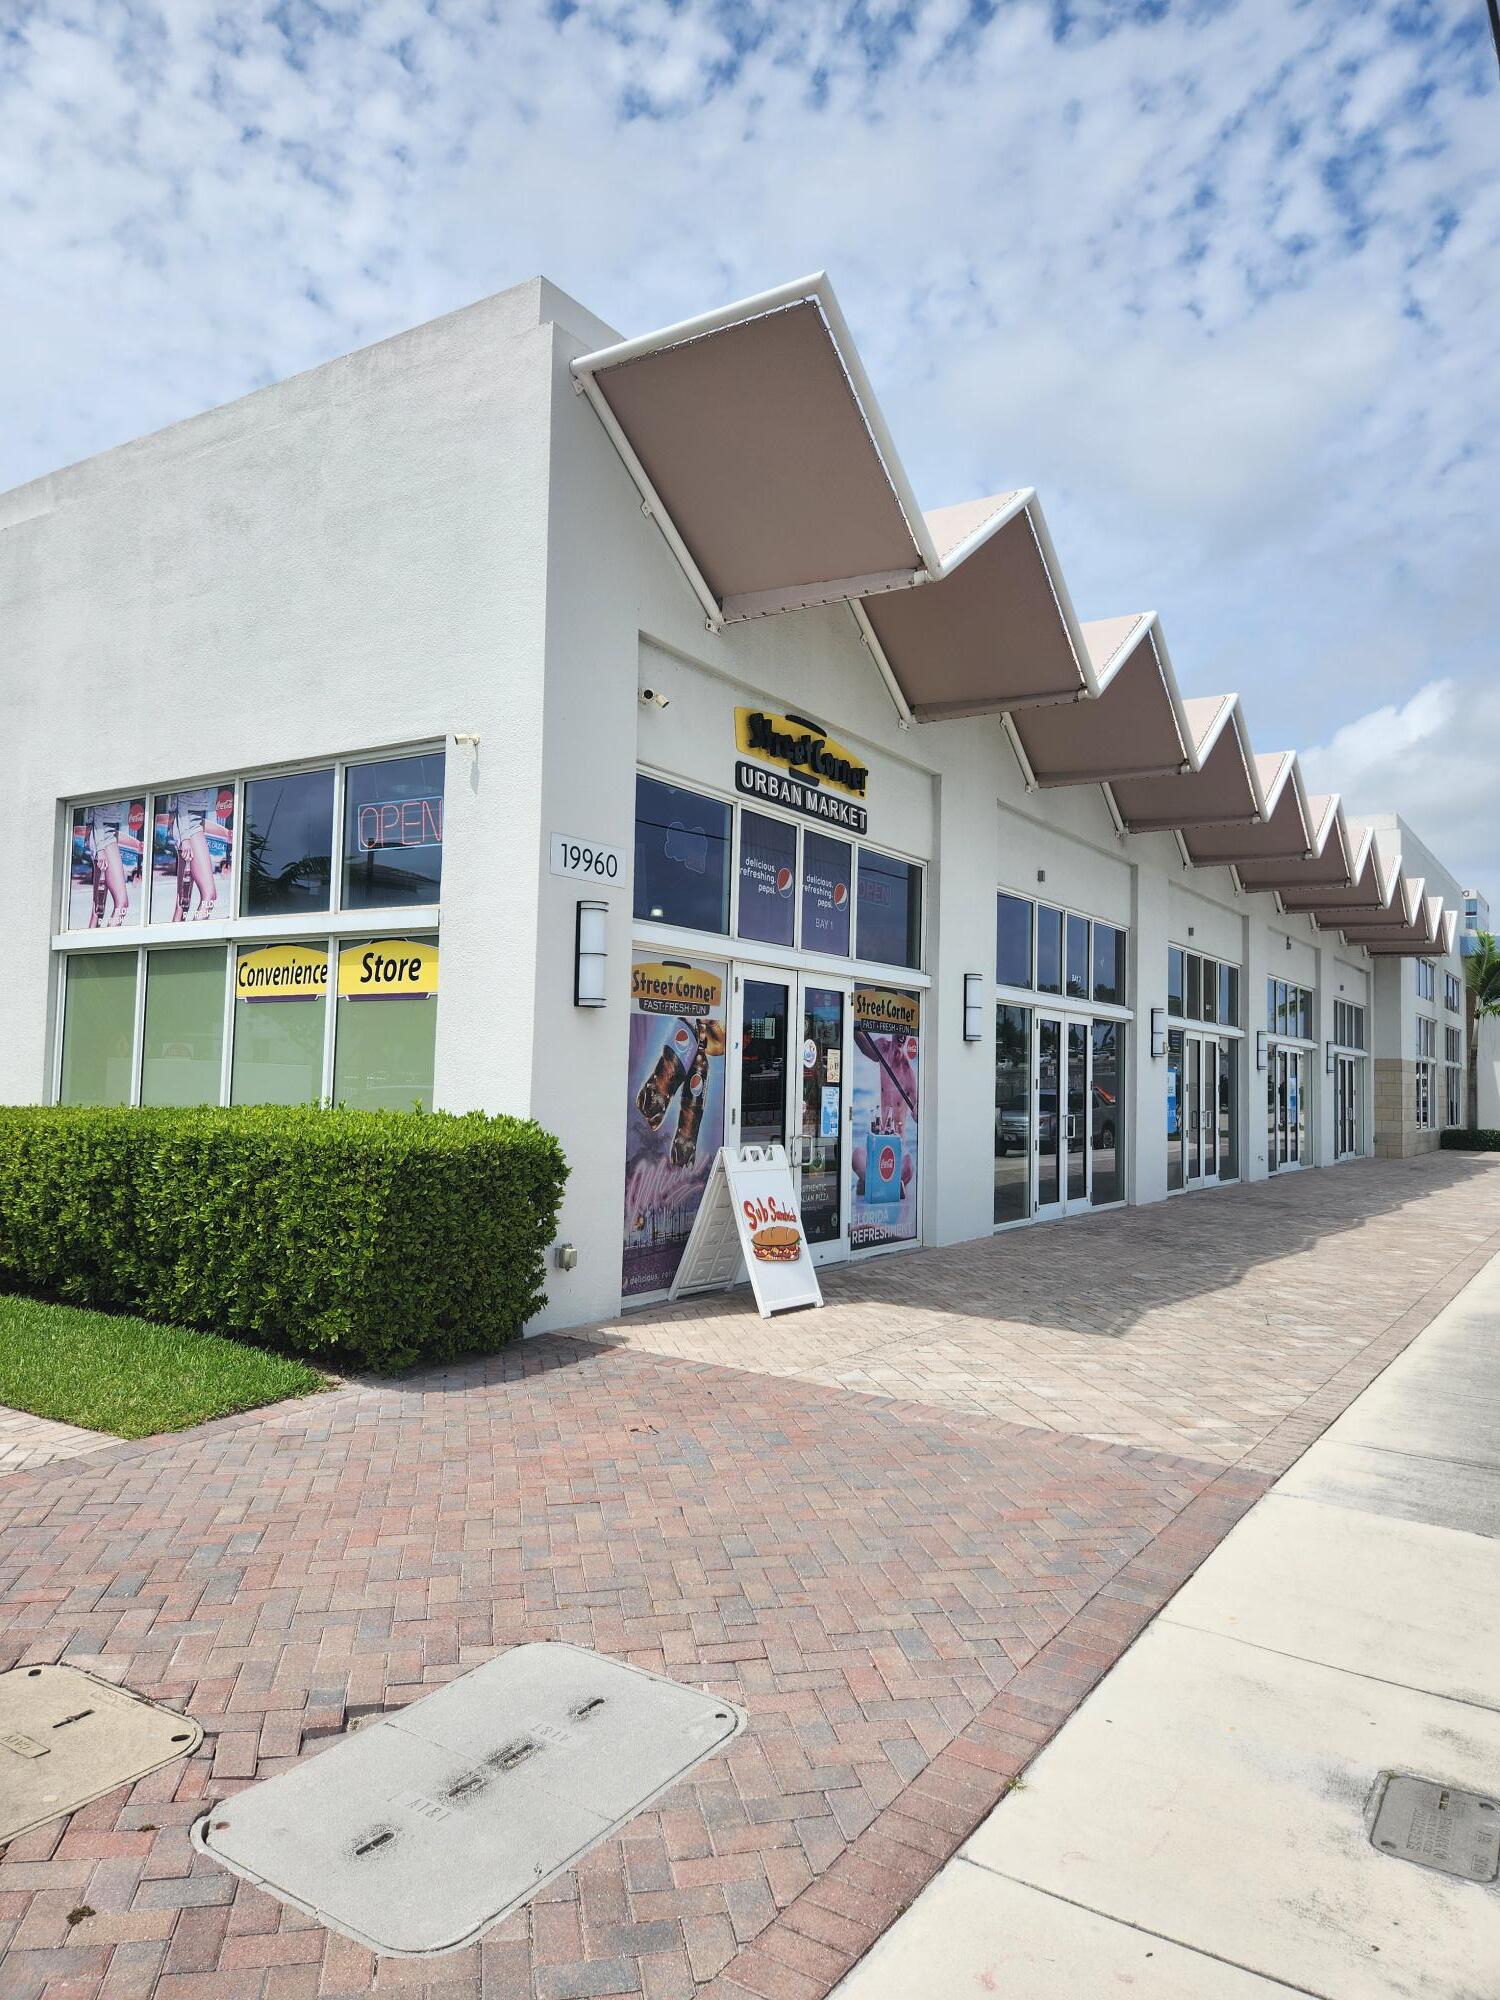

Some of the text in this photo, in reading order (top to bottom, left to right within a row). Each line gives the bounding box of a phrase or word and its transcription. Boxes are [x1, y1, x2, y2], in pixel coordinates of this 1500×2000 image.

[741, 766, 867, 829] URBAN MARKET
[361, 801, 443, 849] OPEN
[561, 843, 618, 878] 19960
[745, 856, 777, 873] delicious.
[815, 918, 829, 929] BAY
[238, 952, 422, 987] Convenience Store
[632, 969, 716, 1002] Street Corner
[856, 994, 915, 1022] Street Corner
[743, 1196, 769, 1231] Sub
[851, 1208, 889, 1227] FLORIDA
[852, 1223, 914, 1244] REFRESHMENT
